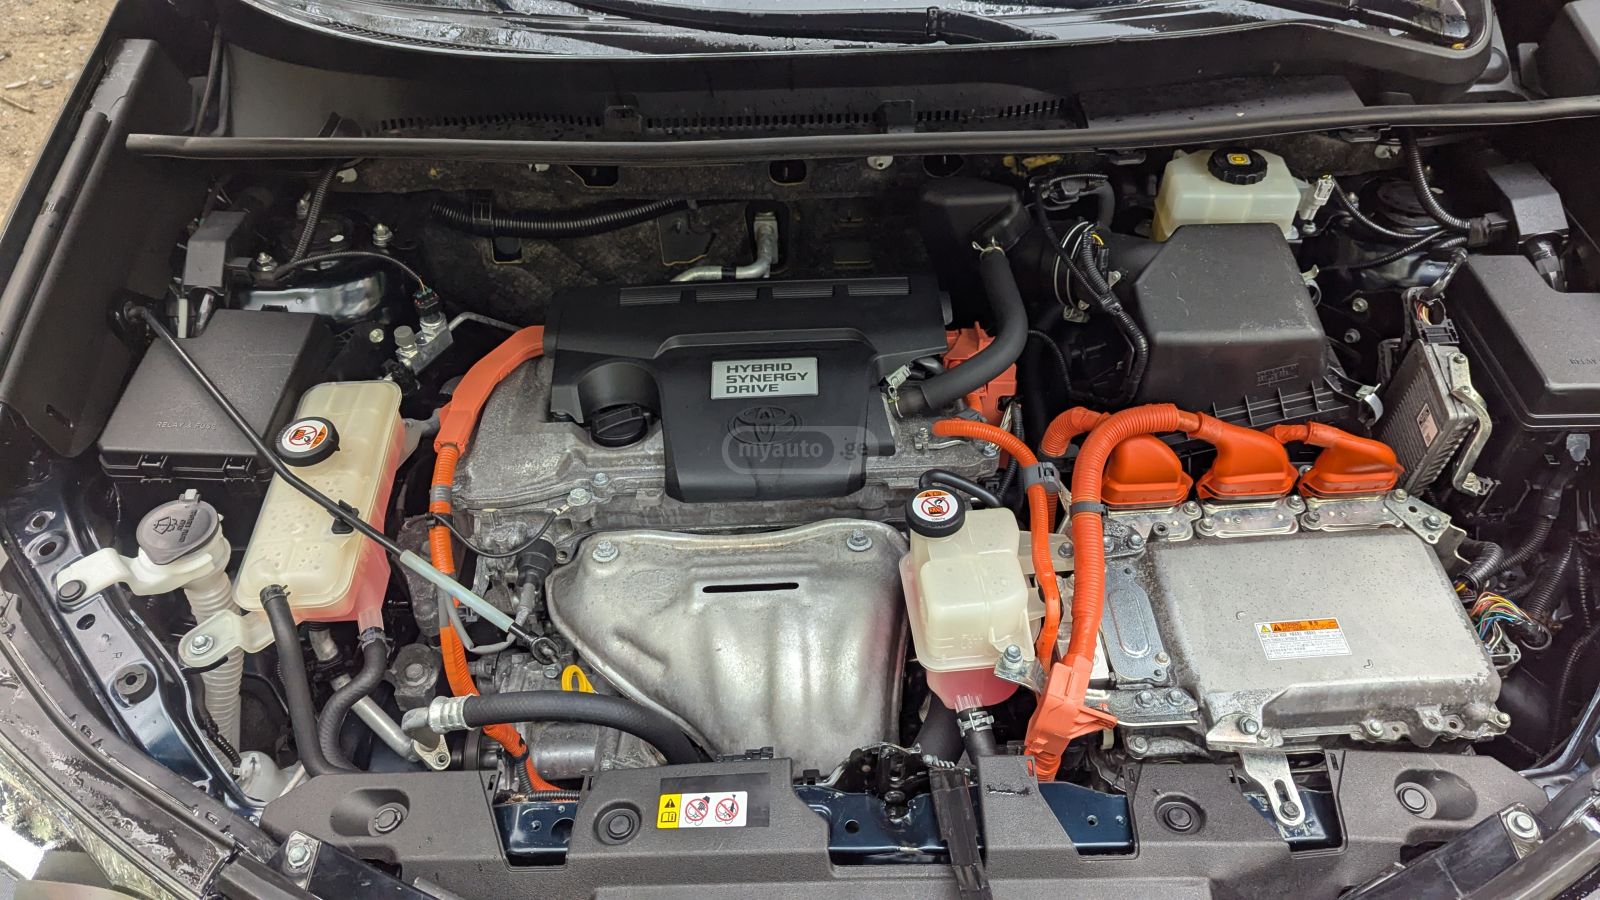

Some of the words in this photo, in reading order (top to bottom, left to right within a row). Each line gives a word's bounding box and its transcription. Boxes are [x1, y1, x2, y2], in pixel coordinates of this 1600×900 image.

[726, 362, 793, 374] HYBRID
[726, 372, 809, 384] SYNERGY
[726, 383, 780, 394] DRIVE
